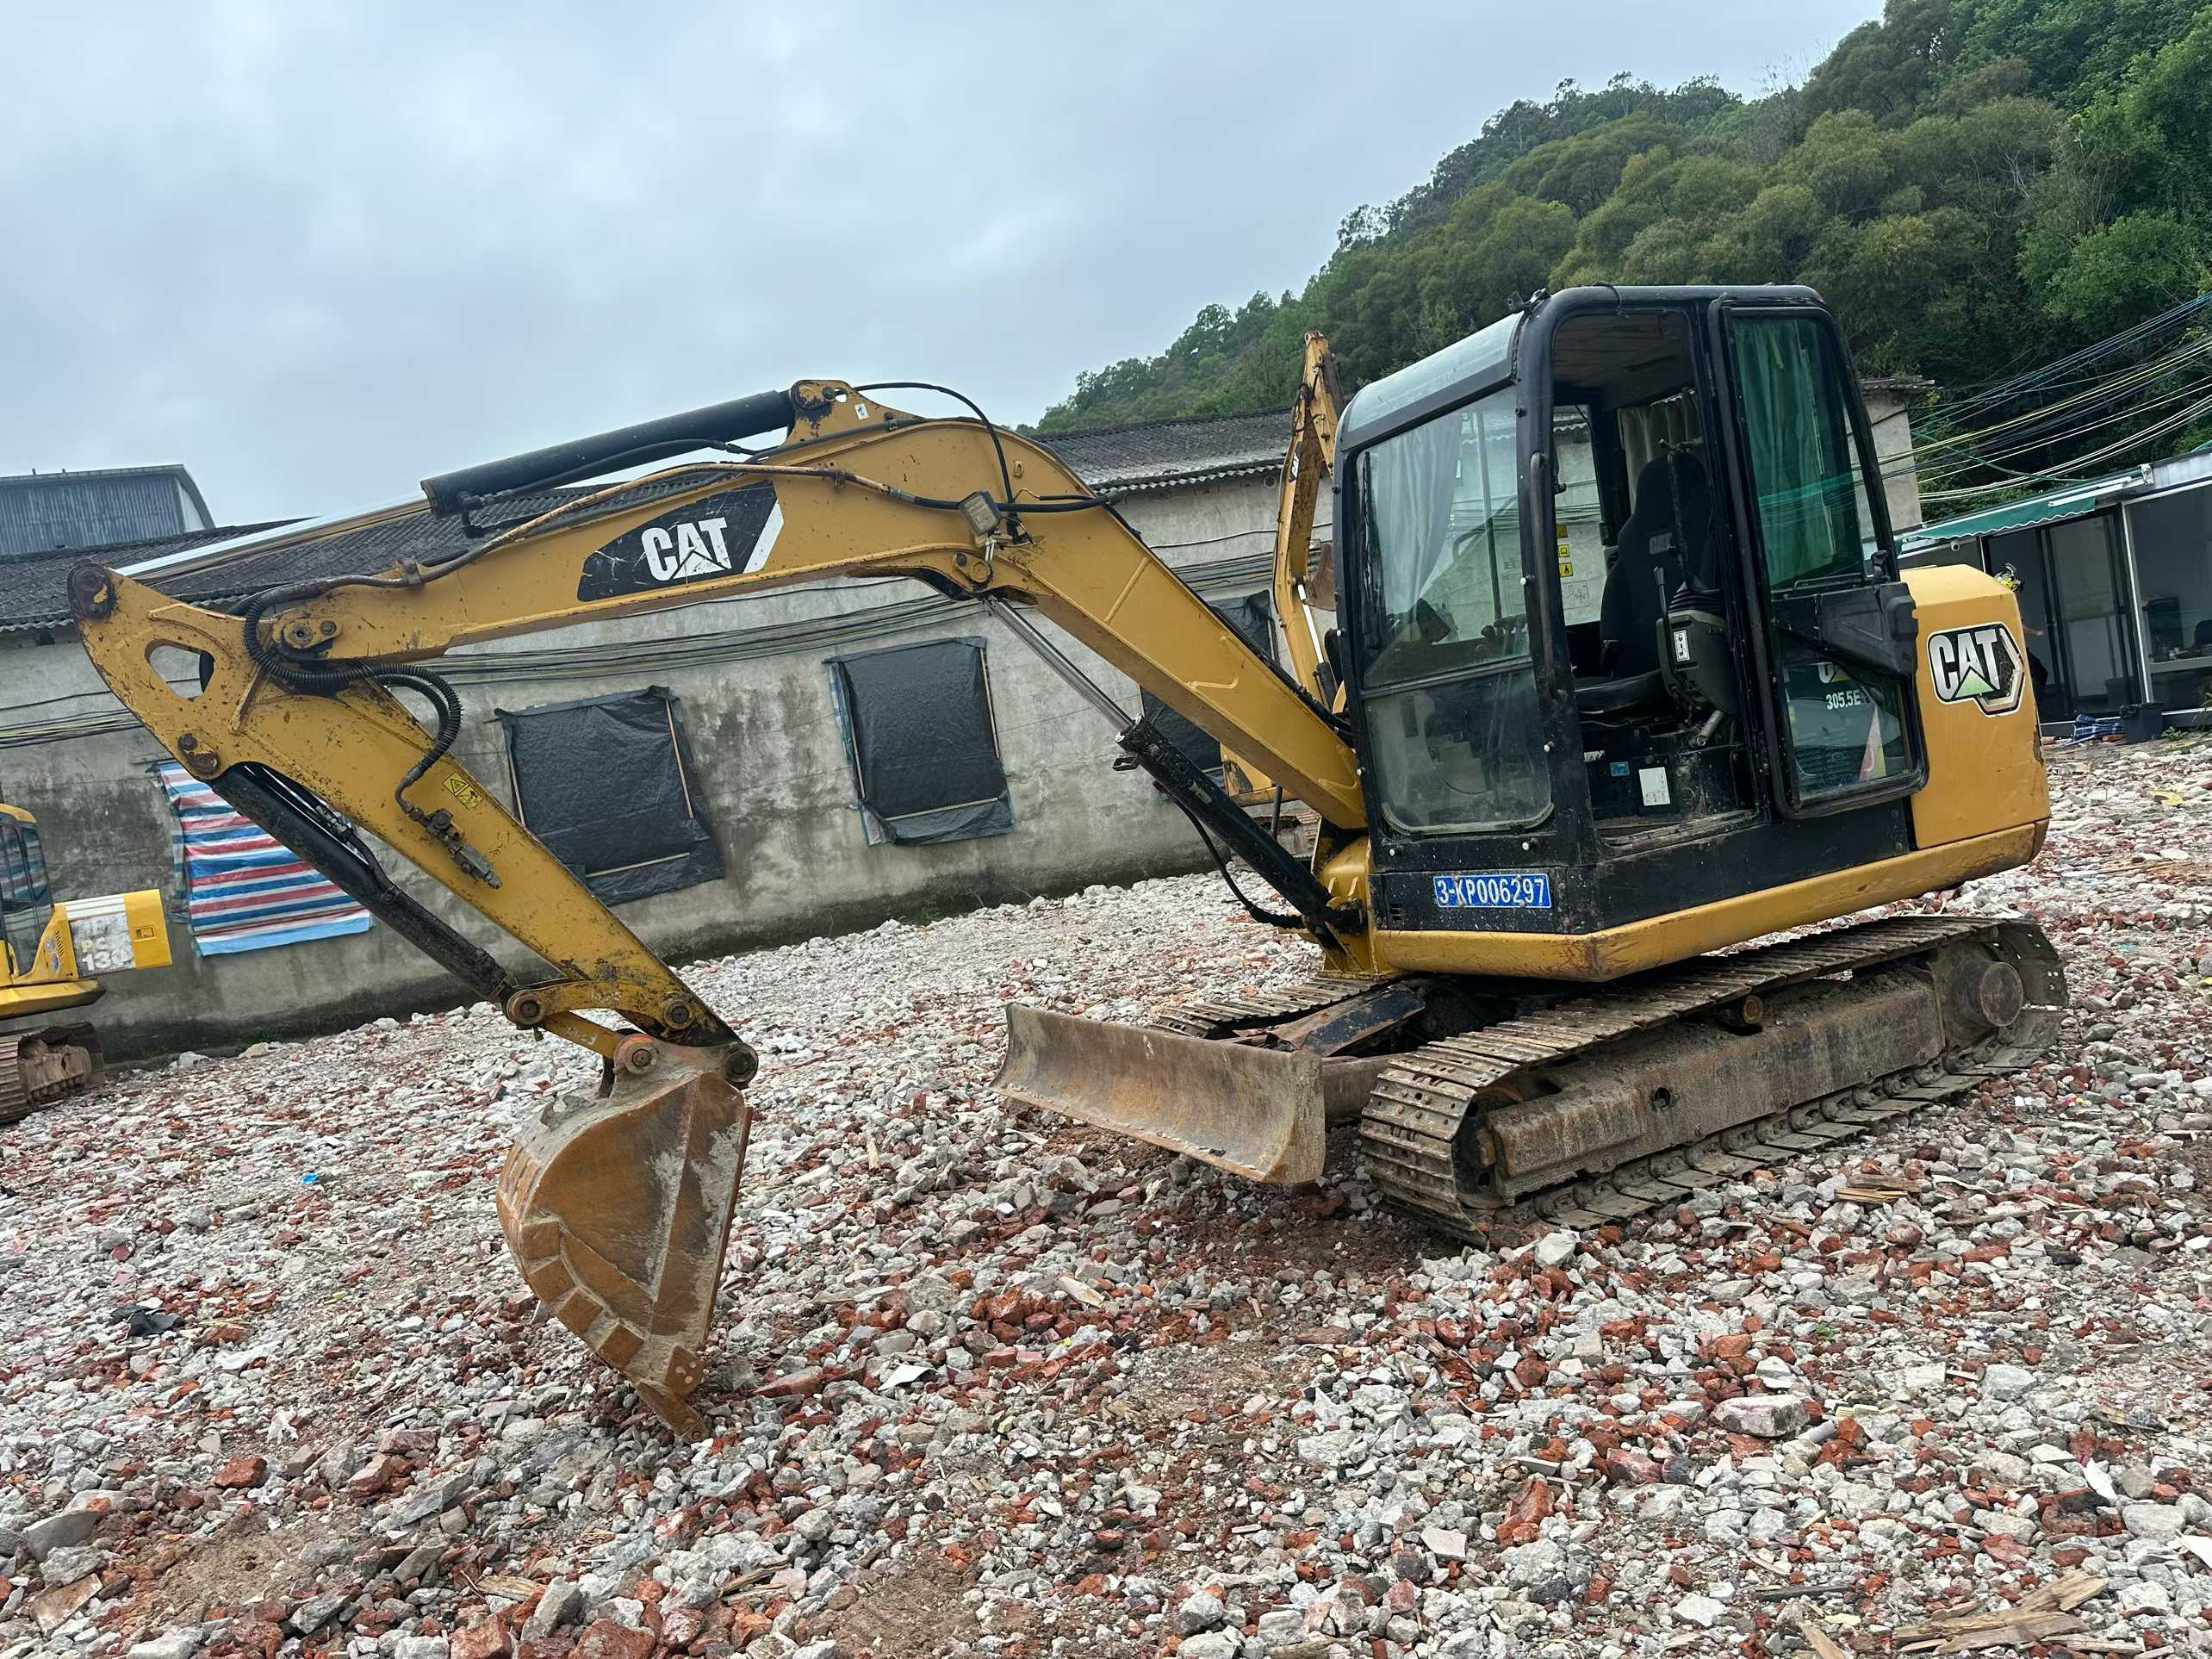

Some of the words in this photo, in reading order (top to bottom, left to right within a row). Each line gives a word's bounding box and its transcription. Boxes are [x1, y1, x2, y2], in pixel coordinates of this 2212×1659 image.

[641, 517, 732, 581] CAT
[1929, 629, 2001, 700] CAT
[1438, 878, 1544, 904] 3-KP006297
